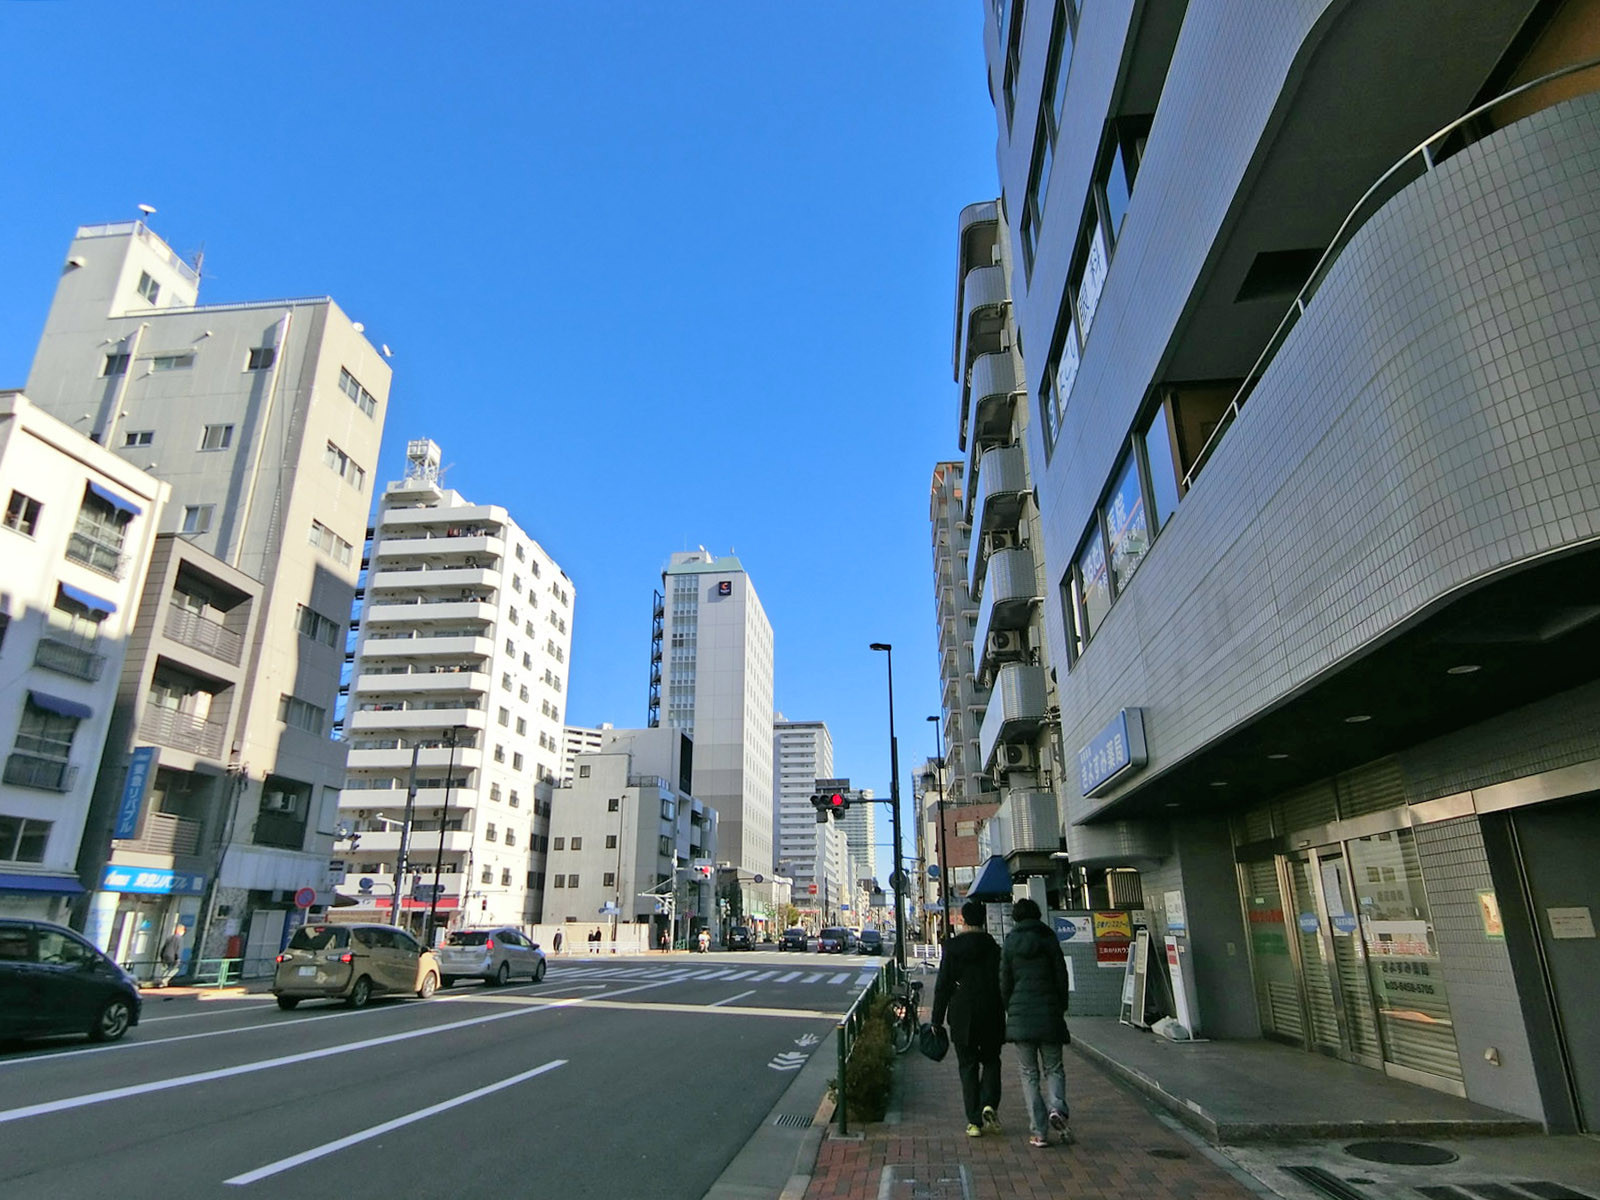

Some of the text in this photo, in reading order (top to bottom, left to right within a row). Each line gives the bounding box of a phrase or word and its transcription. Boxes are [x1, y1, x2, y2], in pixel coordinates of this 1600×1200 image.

[1081, 733, 1123, 789] きよすみ薬局
[120, 763, 146, 834] 東急リバブル
